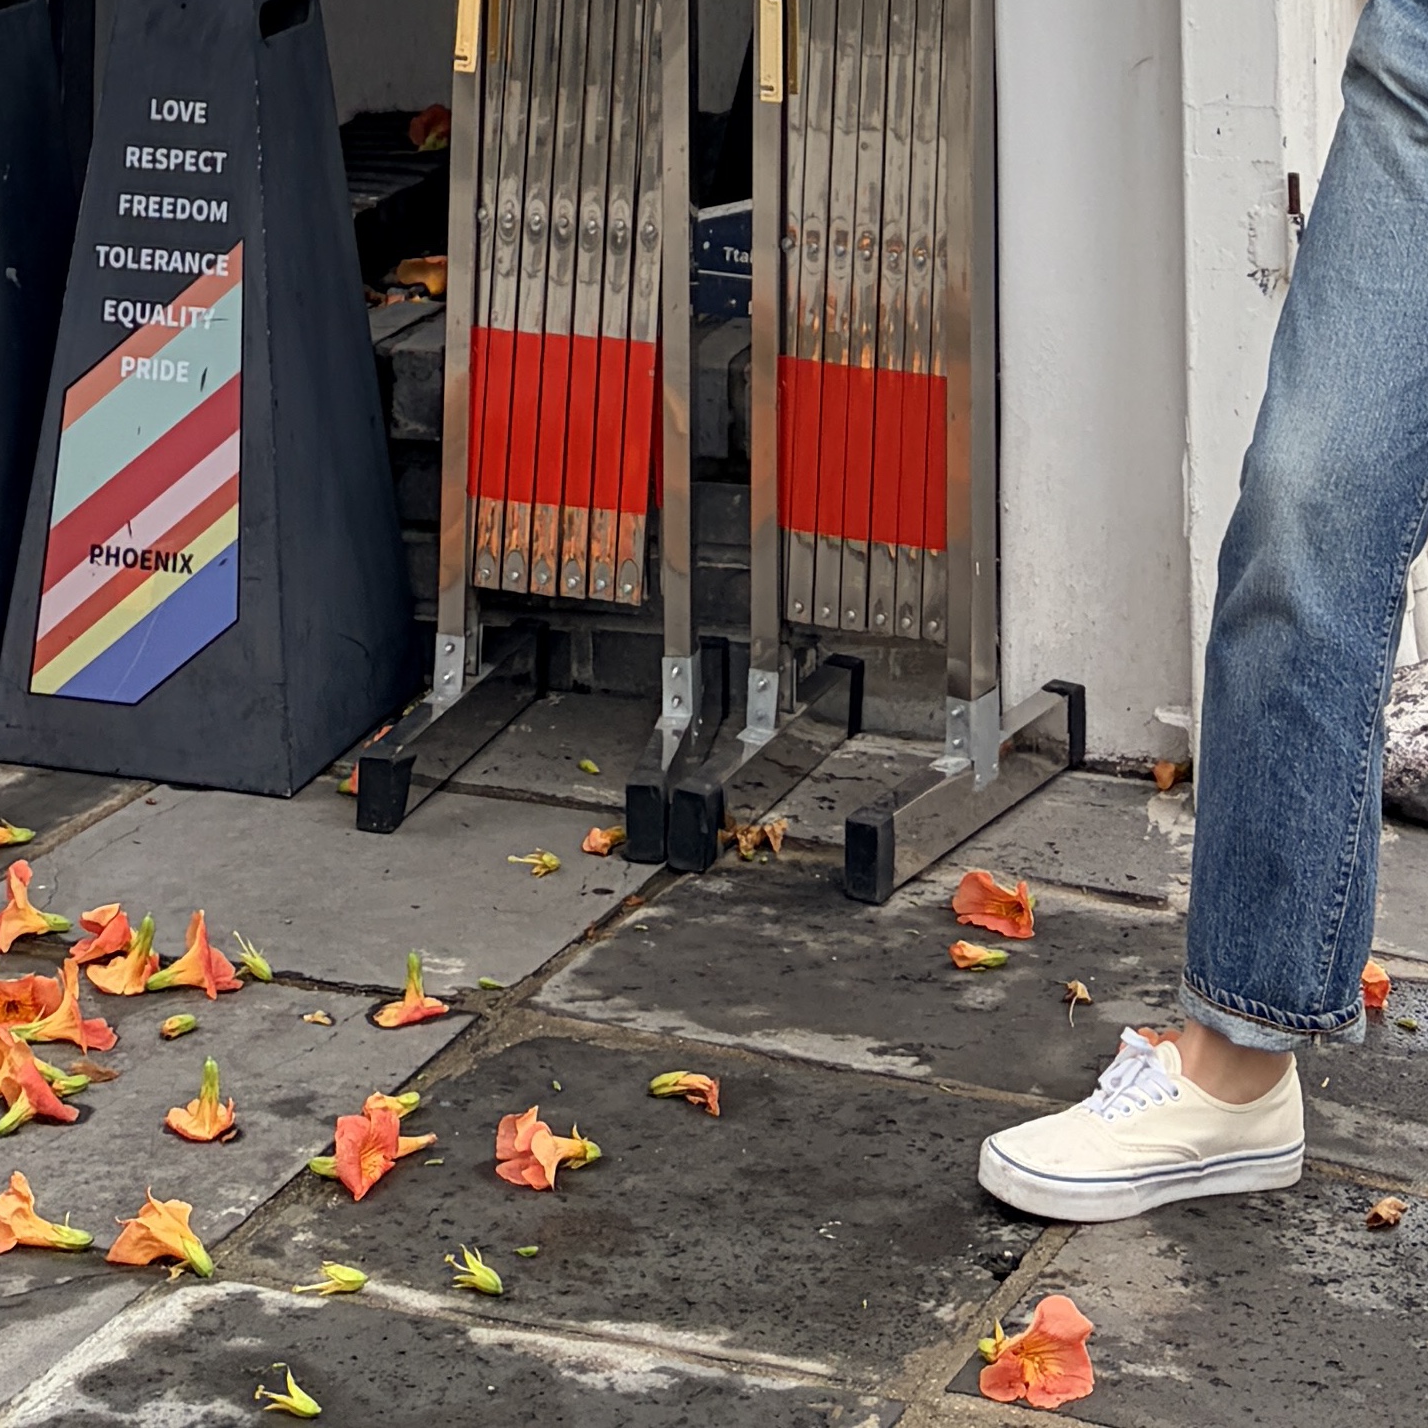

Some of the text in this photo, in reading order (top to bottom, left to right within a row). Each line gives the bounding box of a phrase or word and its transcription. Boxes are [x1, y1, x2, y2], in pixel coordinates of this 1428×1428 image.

[150, 98, 207, 124] LOVE
[125, 146, 227, 174] RESPECT
[118, 194, 228, 223] FREEDOM
[95, 245, 229, 276] TOLERANCE
[103, 299, 216, 330] EQUALITY
[120, 356, 190, 383] PRIDE
[89, 544, 194, 574] PHOENIX
